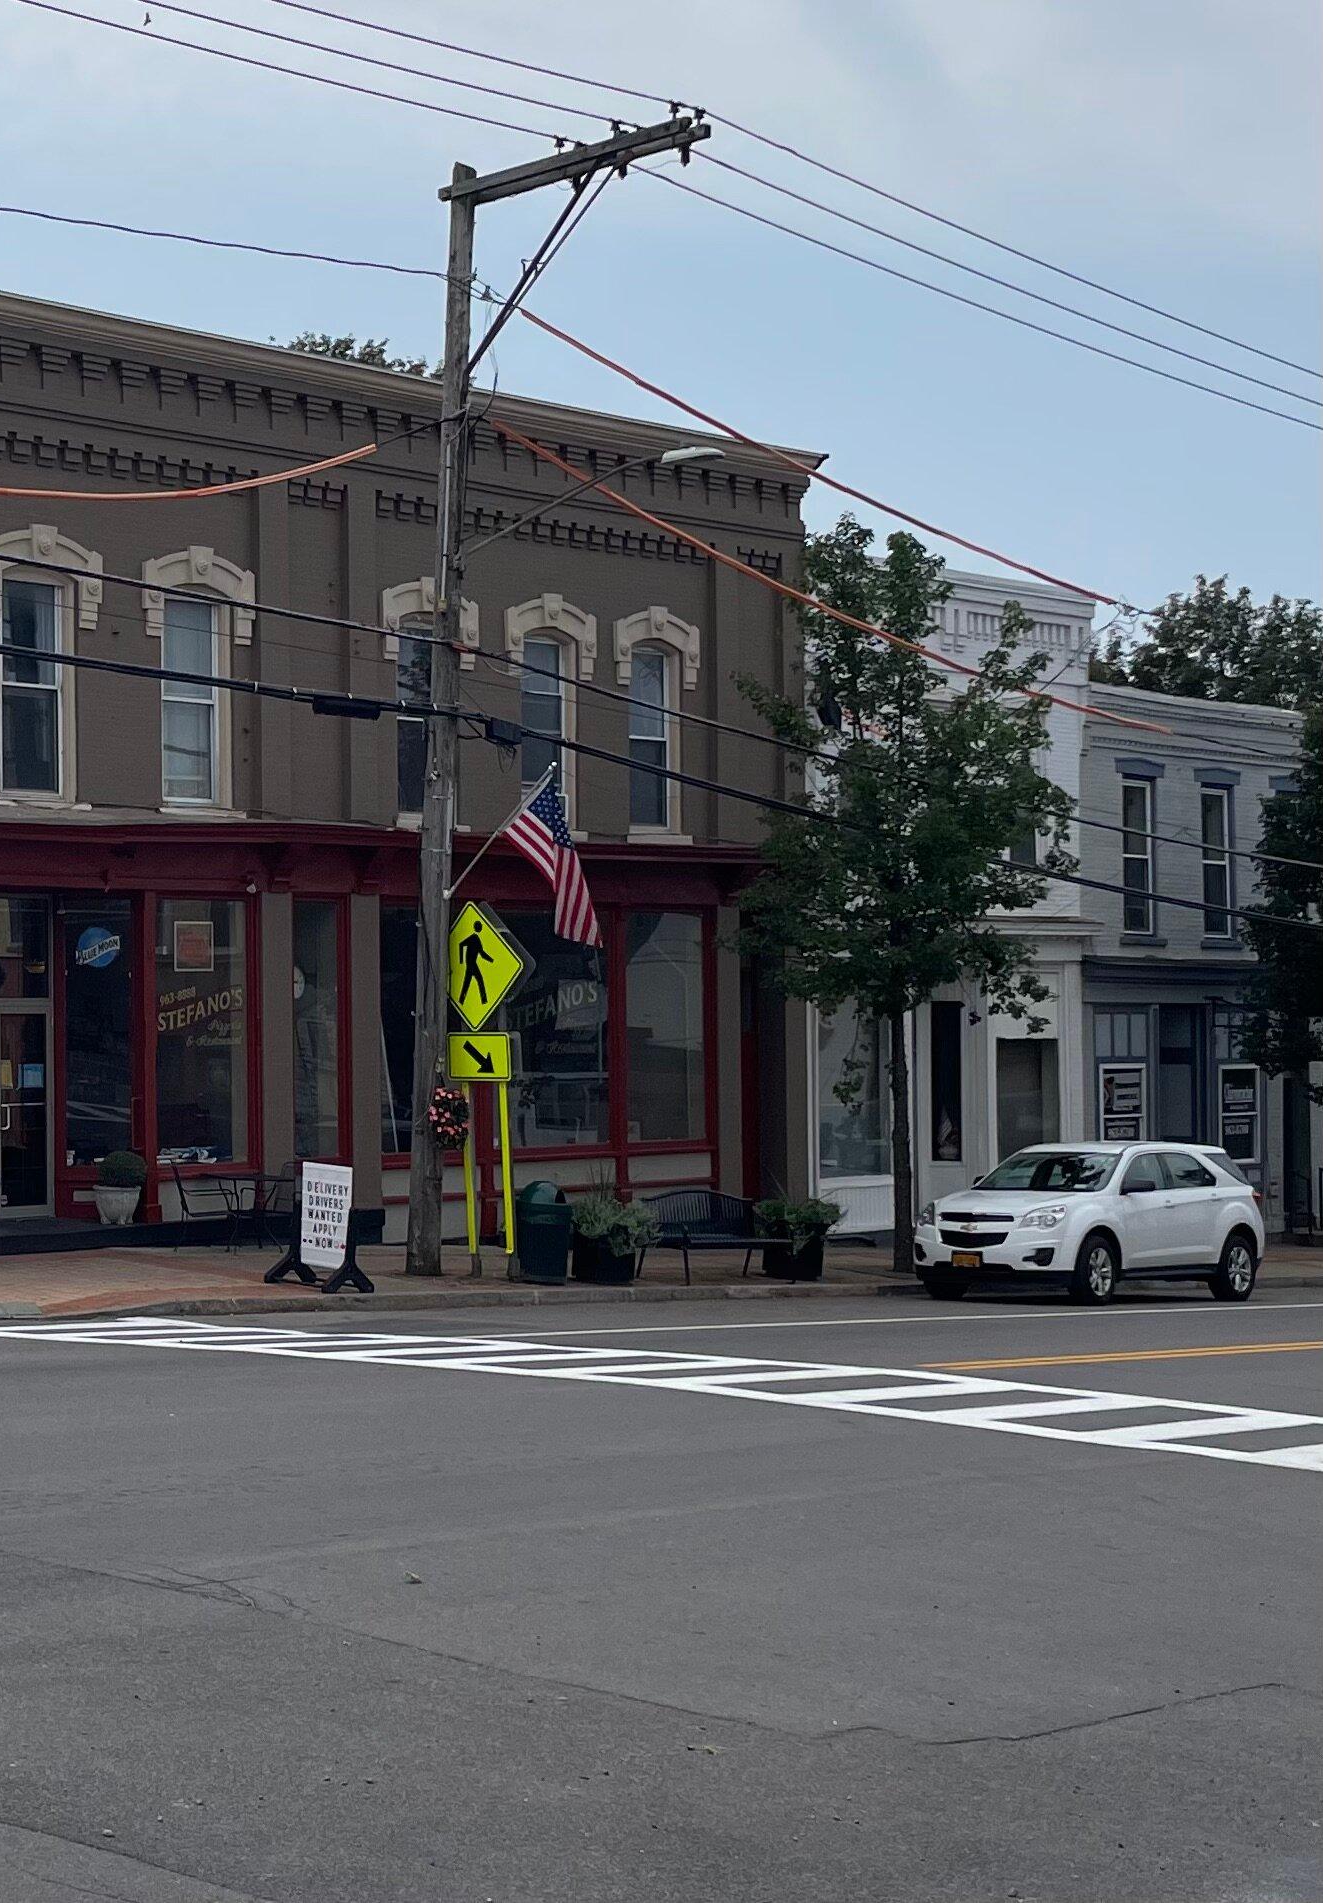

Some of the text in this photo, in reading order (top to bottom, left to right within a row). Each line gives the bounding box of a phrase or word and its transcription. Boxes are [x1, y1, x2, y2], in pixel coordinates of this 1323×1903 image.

[98, 938, 119, 955] MOON
[157, 988, 243, 1032] STEFANO'S
[307, 1181, 348, 1197] DELIVERY
[309, 1195, 343, 1210] DRIVERS
[308, 1209, 343, 1223] WANTED
[312, 1223, 337, 1237] APPLY
[315, 1237, 333, 1249] NOW
